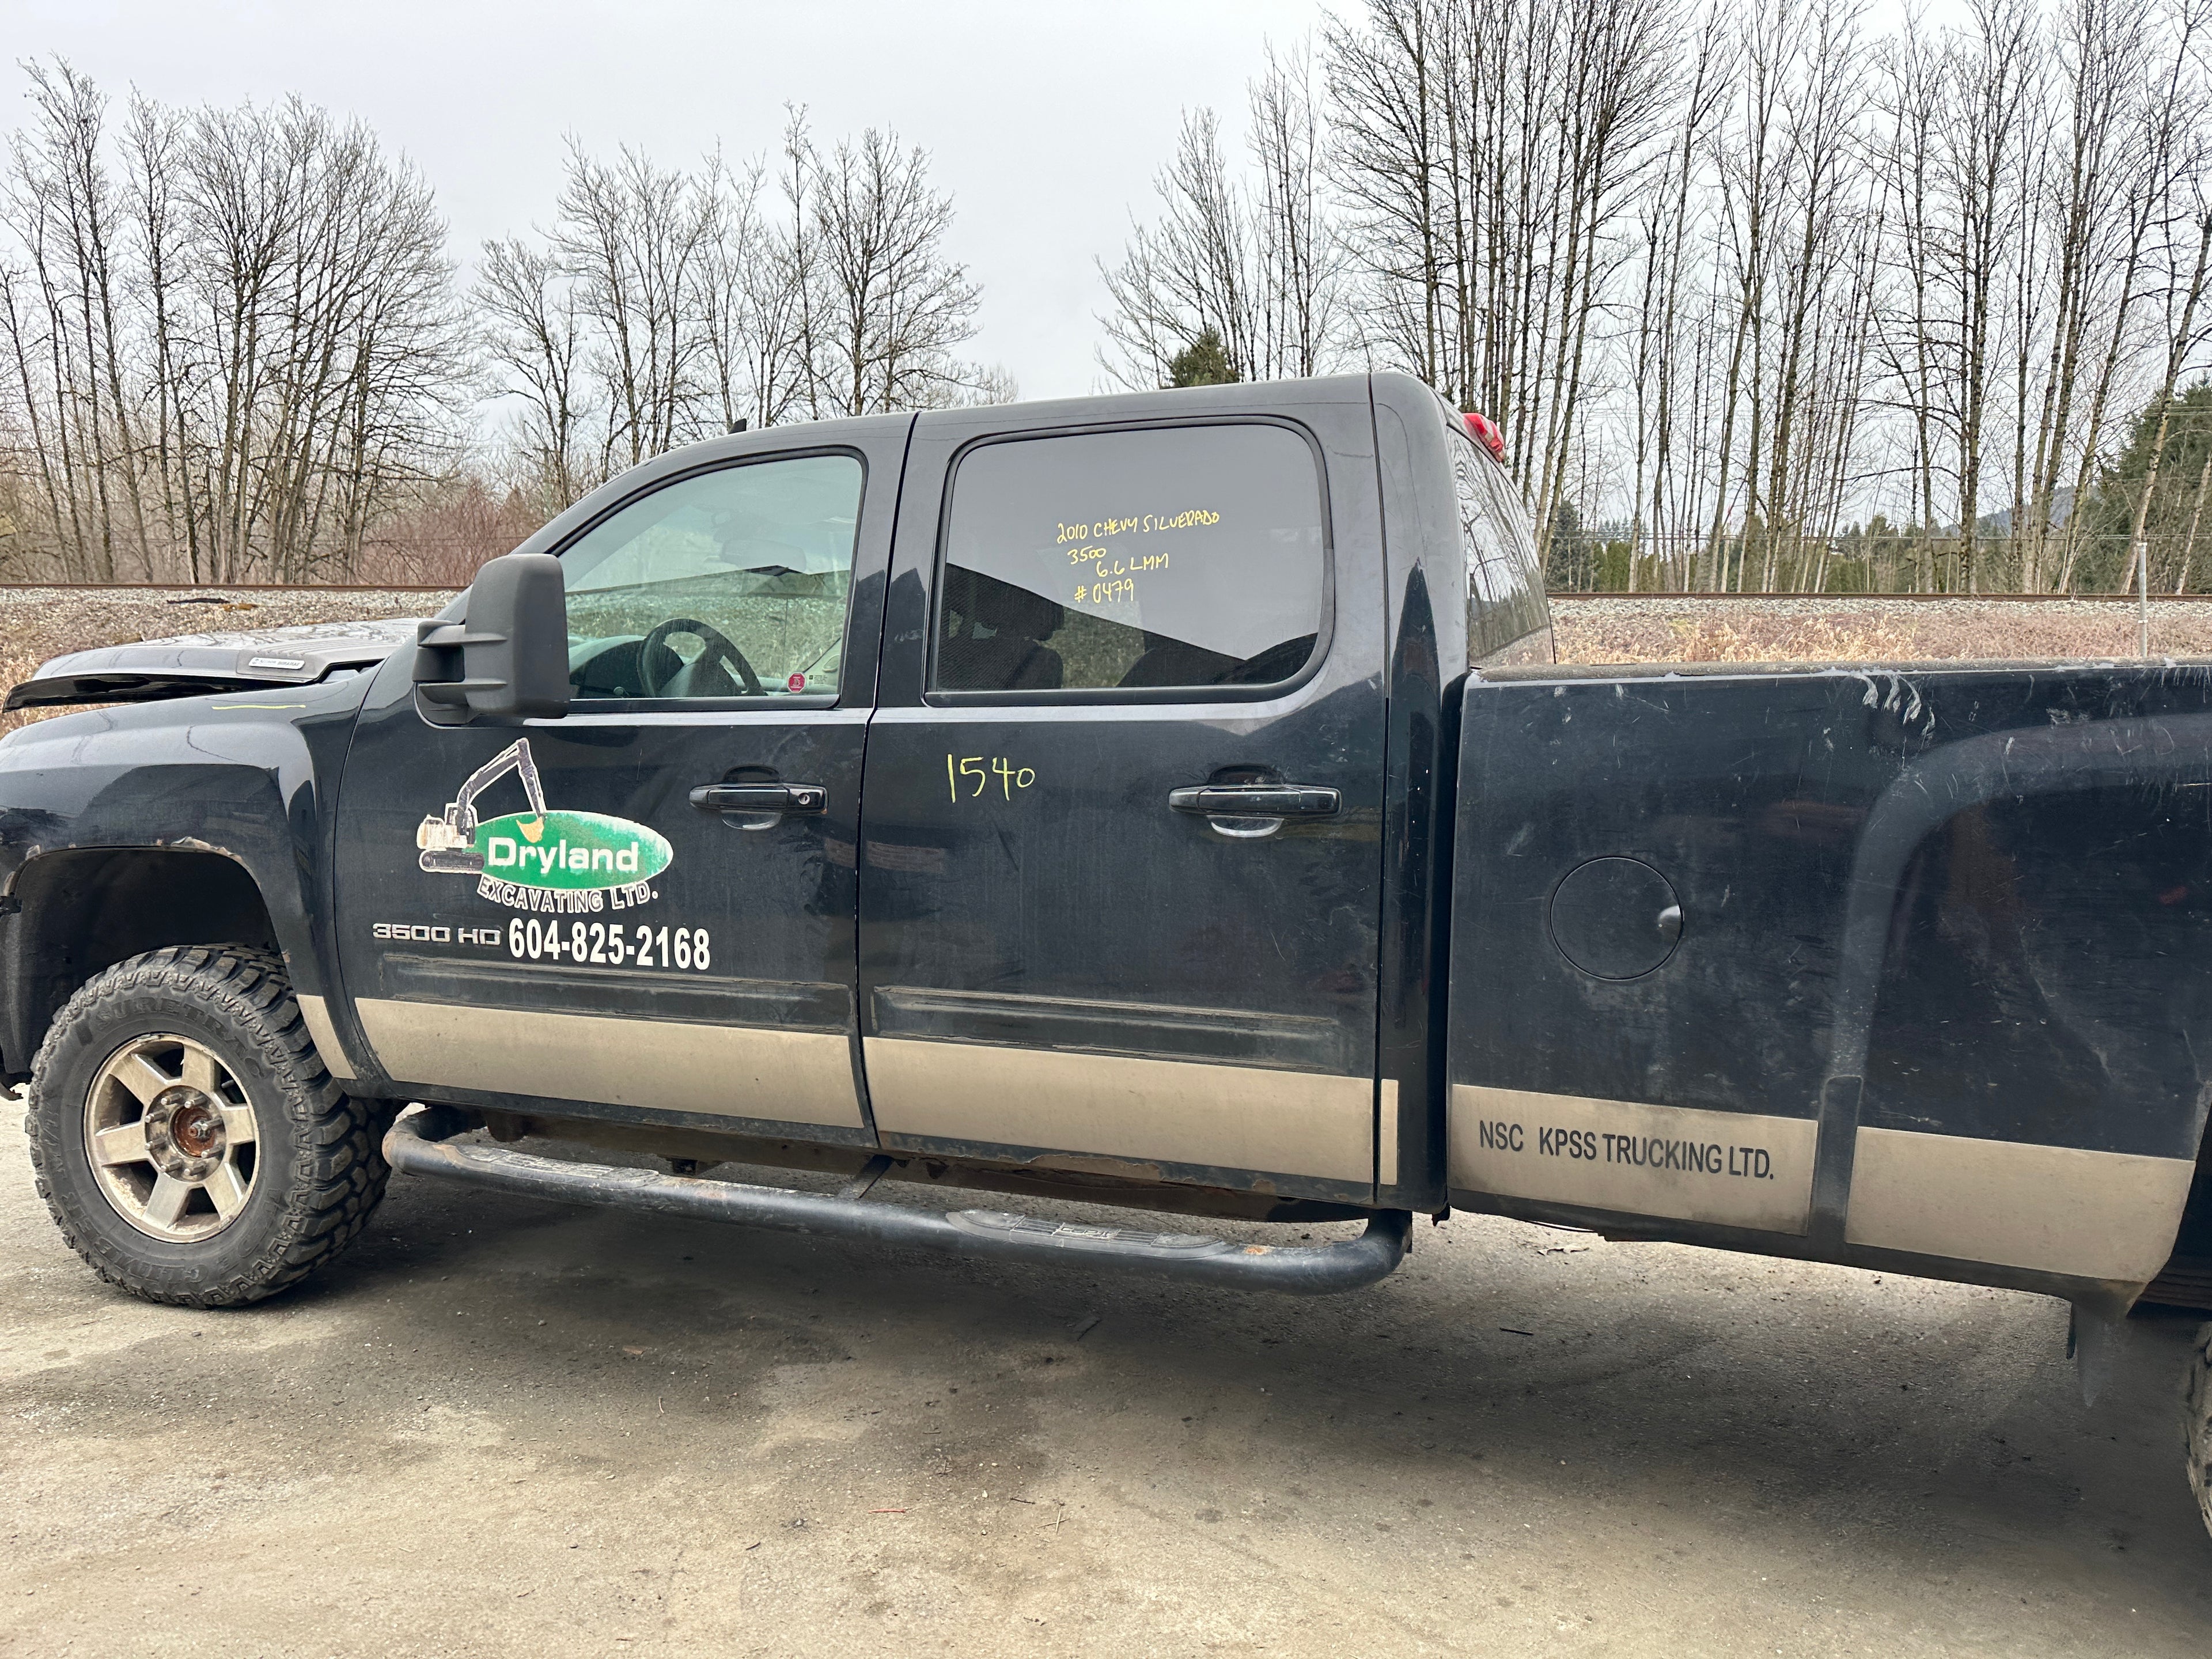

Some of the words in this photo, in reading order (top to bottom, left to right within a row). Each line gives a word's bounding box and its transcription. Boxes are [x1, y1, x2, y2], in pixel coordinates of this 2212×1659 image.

[1057, 523, 1088, 544] 2010
[1093, 517, 1138, 537] CHEVY
[1143, 510, 1220, 533] SILVERADO
[1067, 546, 1106, 565] 3500
[1096, 560, 1125, 577] 6.6
[1130, 552, 1169, 570] LMM
[947, 753, 1035, 803] 1540
[488, 837, 639, 873] Dryland
[477, 875, 604, 912] EXCAVATING
[610, 880, 659, 910] LTD.
[373, 923, 450, 944] 3500
[458, 928, 501, 945] HD
[509, 917, 711, 970] 604-825-2168
[1479, 1119, 1524, 1152] NSC
[1539, 1126, 1597, 1161] KPSS
[1601, 1134, 1722, 1174] TRUCKING
[1728, 1145, 1774, 1180] LTD.
